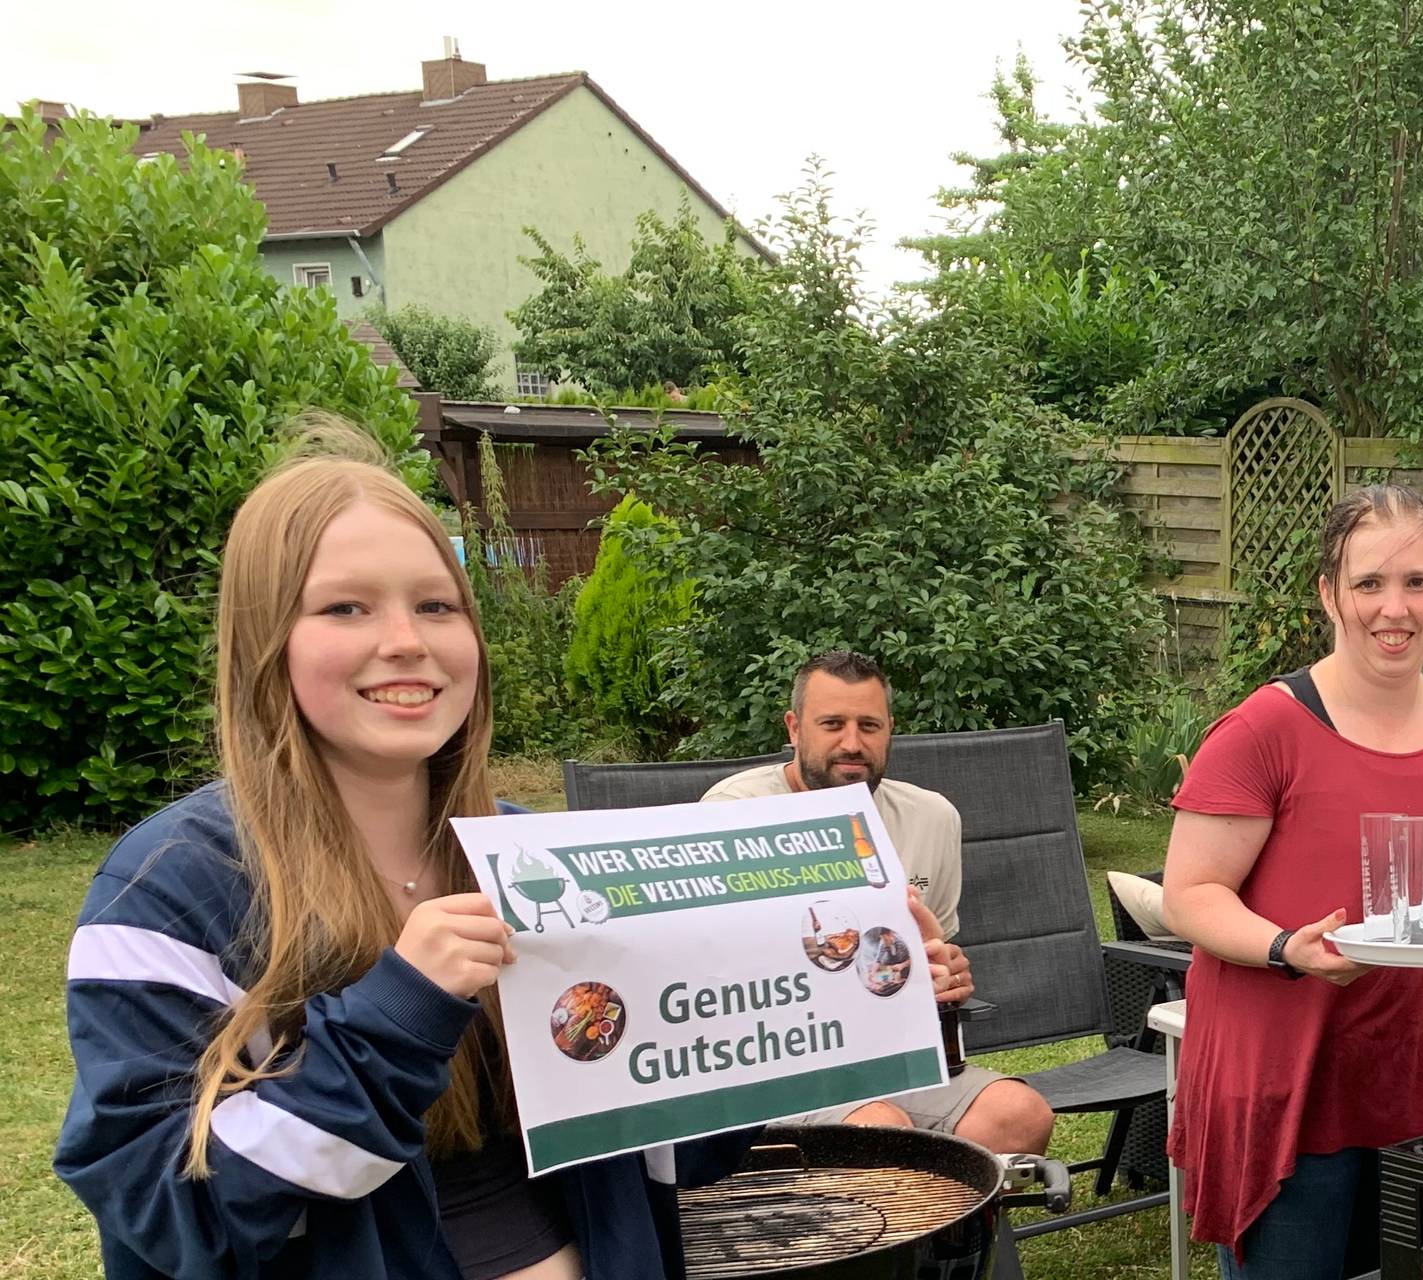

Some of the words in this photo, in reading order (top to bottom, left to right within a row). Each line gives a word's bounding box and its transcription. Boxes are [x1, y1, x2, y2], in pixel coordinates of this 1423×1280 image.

[568, 849, 634, 876] WER
[631, 841, 729, 870] REGIERT
[734, 836, 775, 861] AM
[775, 828, 845, 855] GRILL?
[605, 884, 643, 908] DIE
[640, 875, 728, 903] VELTINS
[725, 860, 866, 893] GENUSS-AKTION
[659, 972, 811, 1024] Genuss
[628, 1011, 844, 1085] Gutschein
